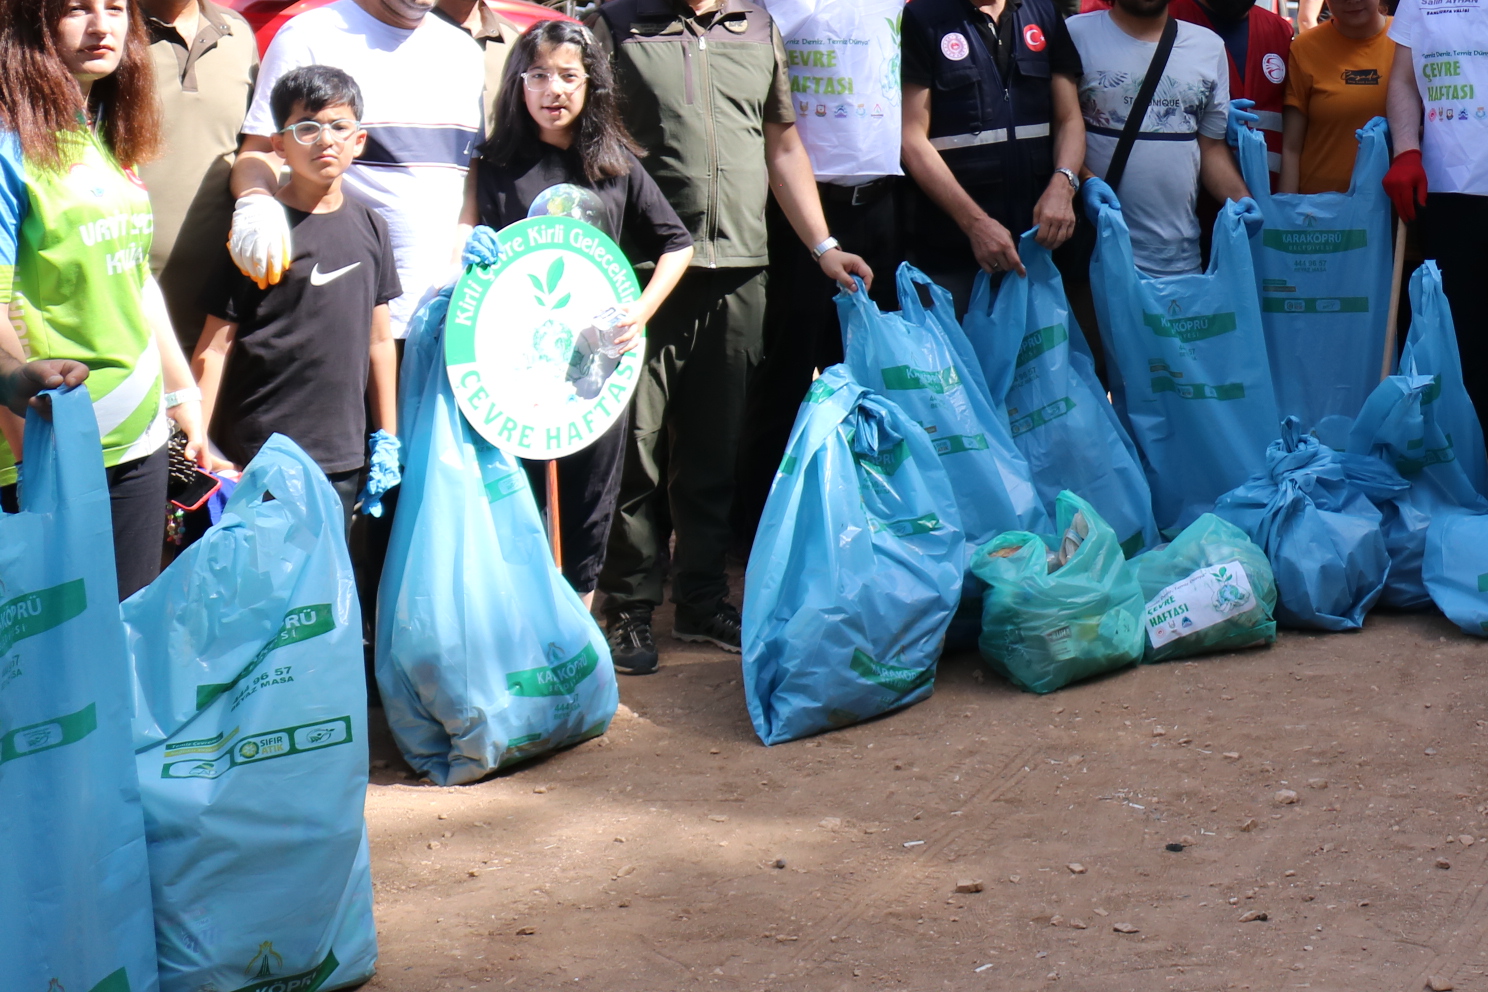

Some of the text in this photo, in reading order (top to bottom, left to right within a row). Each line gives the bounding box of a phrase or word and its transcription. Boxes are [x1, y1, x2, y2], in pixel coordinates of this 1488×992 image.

[788, 50, 837, 68] EVRE
[1422, 61, 1461, 82] ÇEVRE
[791, 75, 854, 95] AFTASI
[1427, 84, 1474, 101] HAFTASI
[454, 280, 483, 326] Kirli
[476, 236, 525, 283] Çvre
[526, 225, 564, 247] Kirli
[455, 370, 535, 449] ÇEVRE
[1149, 603, 1189, 627] HAFTASI
[274, 666, 292, 676] 57
[260, 676, 294, 689] MASA
[260, 736, 282, 747] SIFIR
[261, 745, 284, 755] ATIK
